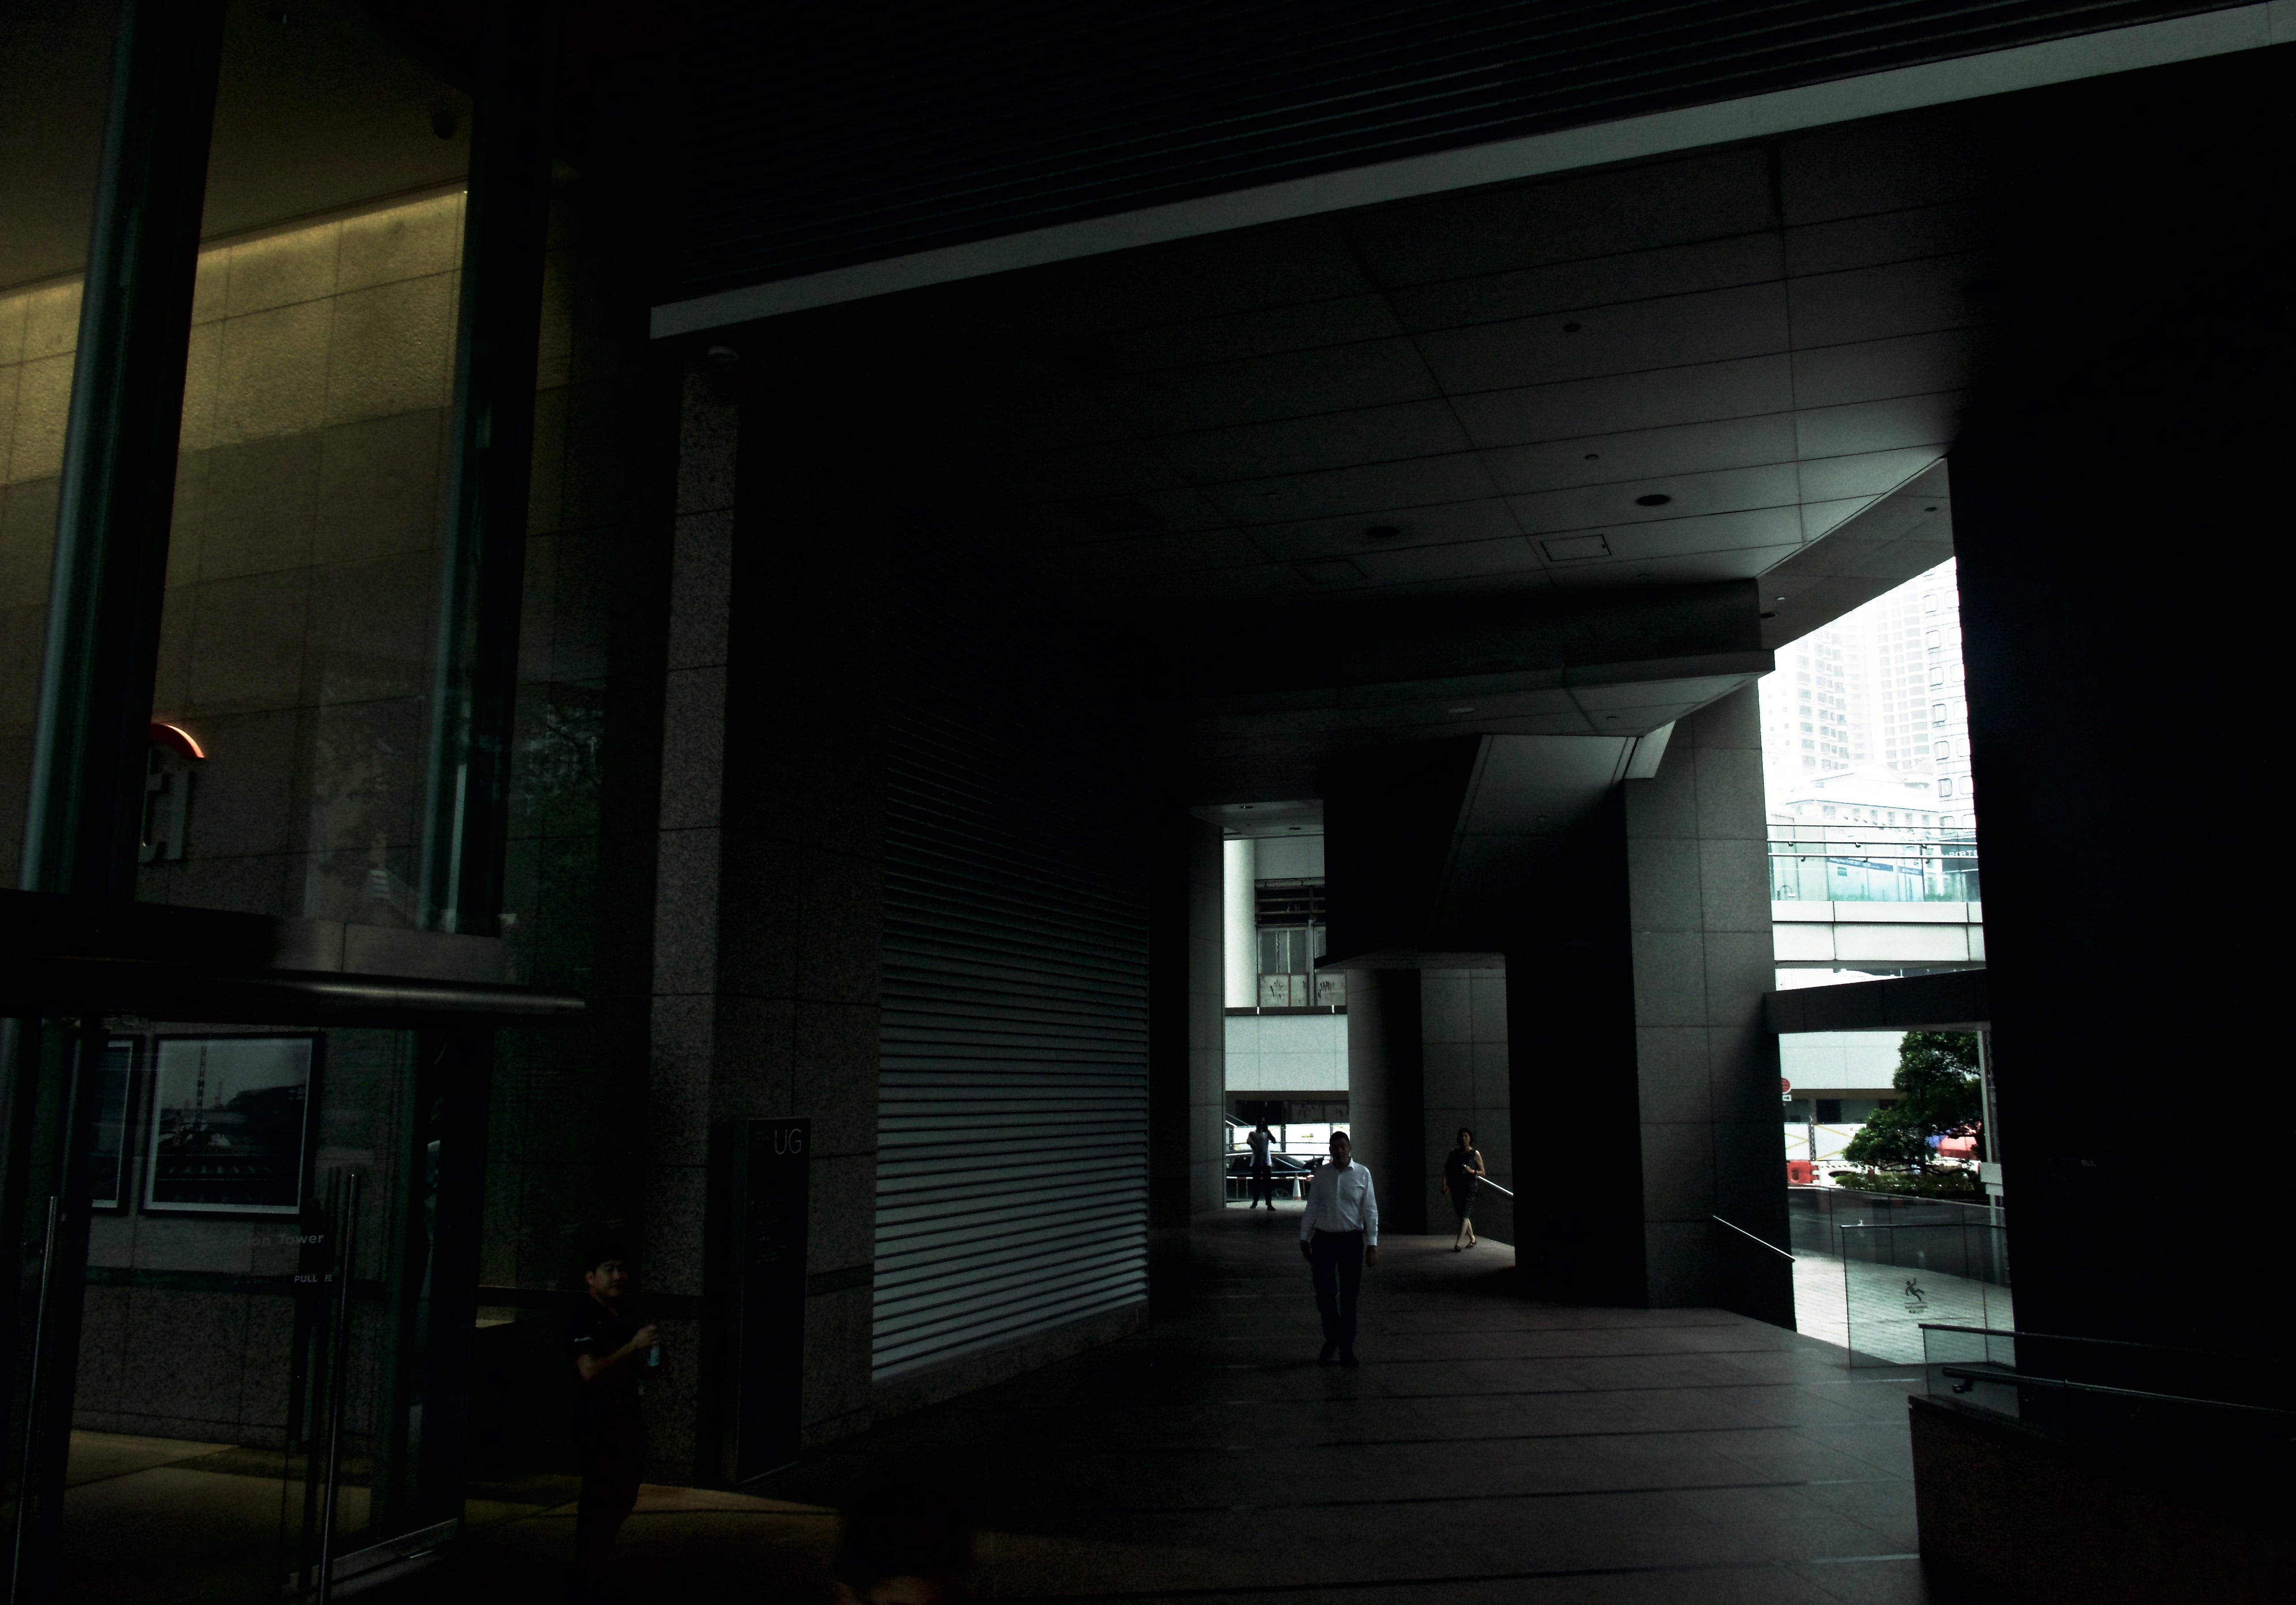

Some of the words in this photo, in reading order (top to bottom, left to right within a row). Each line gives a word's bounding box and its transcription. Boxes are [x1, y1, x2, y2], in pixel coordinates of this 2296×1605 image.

[774, 1128, 802, 1155] UG
[278, 1234, 325, 1245] Tower
[293, 1274, 318, 1283] PULL
